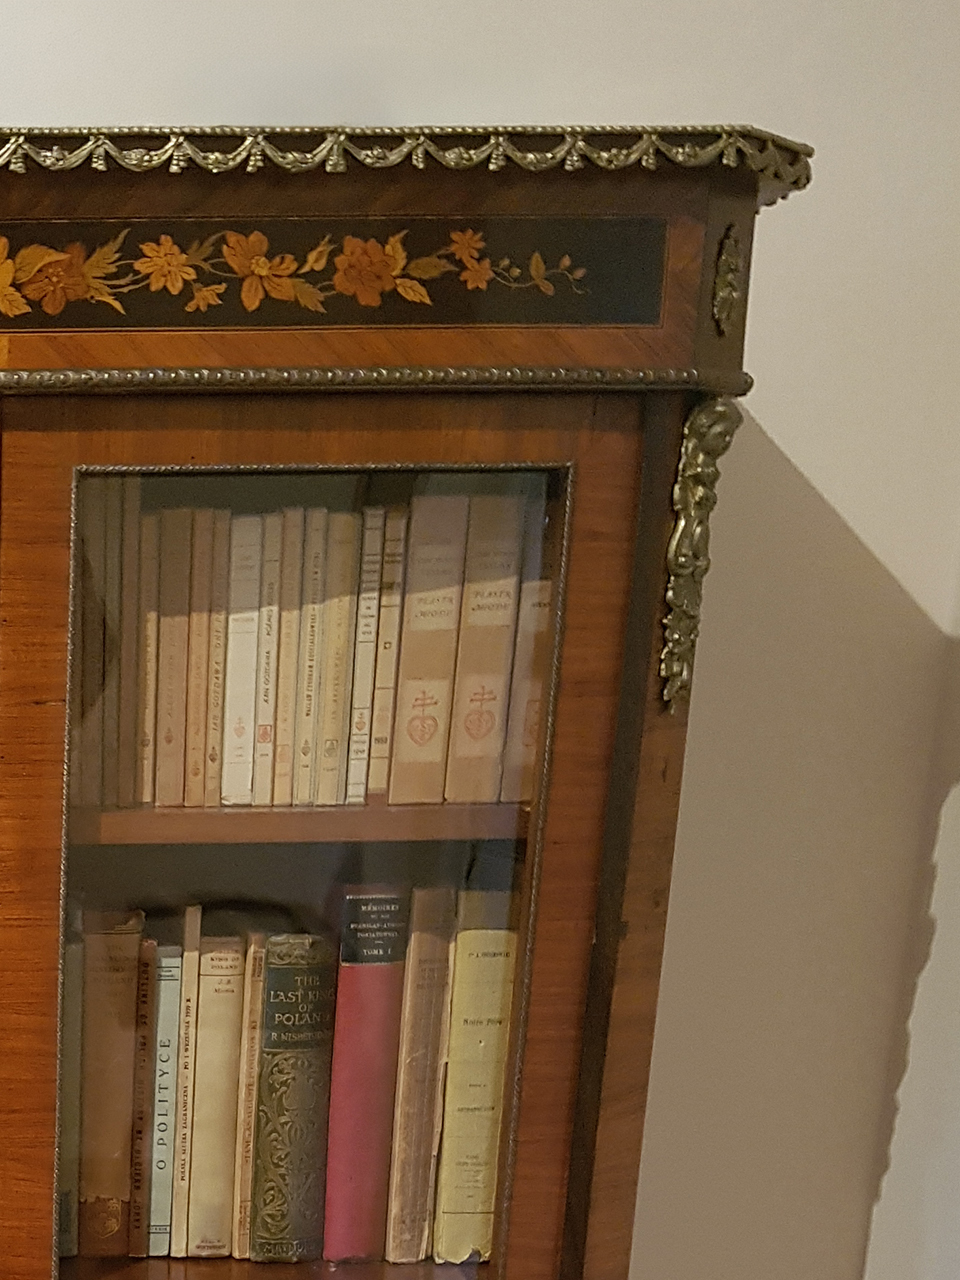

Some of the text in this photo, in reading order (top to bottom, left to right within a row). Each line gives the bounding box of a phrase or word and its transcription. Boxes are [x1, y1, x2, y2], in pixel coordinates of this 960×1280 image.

[294, 976, 320, 987] THE
[269, 989, 304, 1003] LAST
[298, 1003, 314, 1012] OF
[155, 1037, 172, 1170] O POLITYCE
